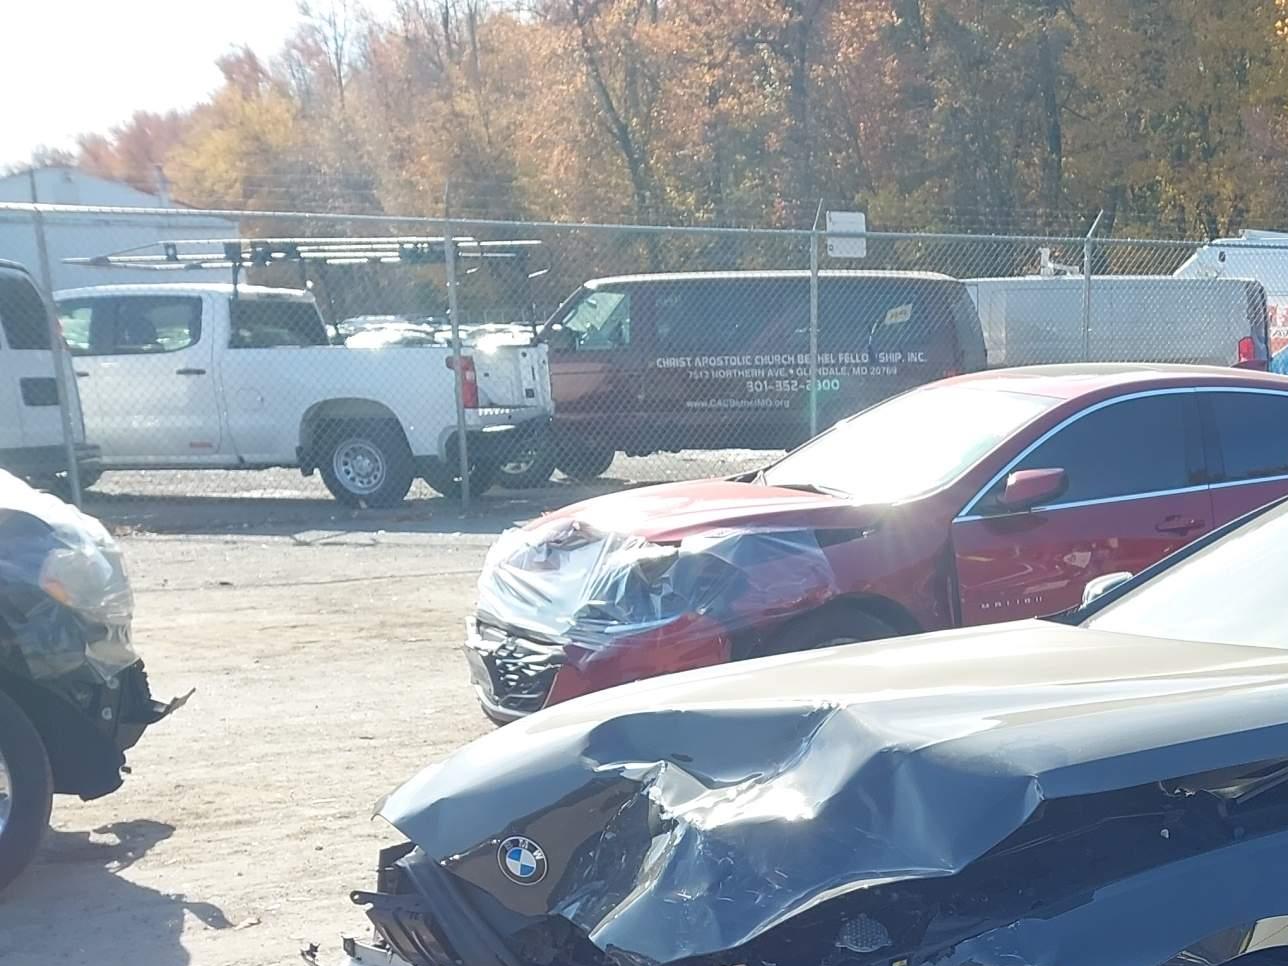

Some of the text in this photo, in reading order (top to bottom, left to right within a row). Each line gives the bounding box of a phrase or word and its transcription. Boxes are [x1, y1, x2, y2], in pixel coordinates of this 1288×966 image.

[656, 356, 692, 368] CHRIST
[694, 355, 753, 367] APOSTOLIC
[754, 354, 794, 365] CHURCH
[797, 353, 838, 365] BEHEL
[711, 368, 765, 379] NORTHERN
[852, 366, 868, 376] MD
